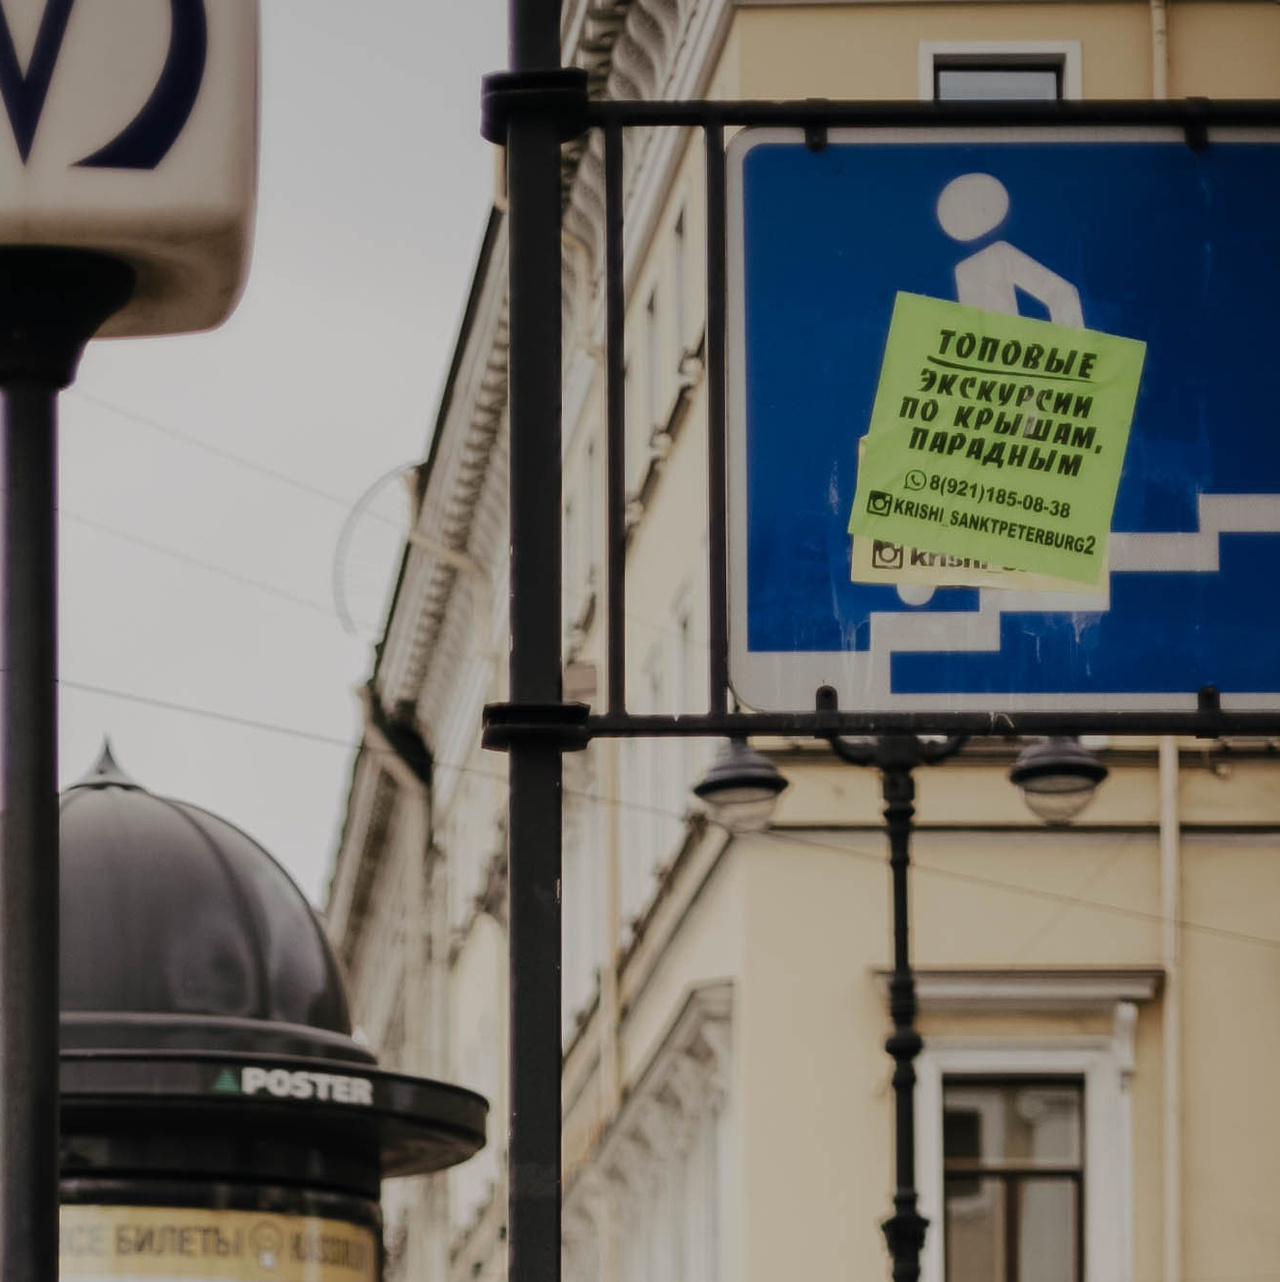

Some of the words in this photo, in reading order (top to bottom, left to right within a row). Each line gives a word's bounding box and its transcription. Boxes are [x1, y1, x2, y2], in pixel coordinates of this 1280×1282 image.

[938, 329, 1098, 379] ТОПОВЫЕ
[919, 367, 1094, 419] ЭКСКУРСИИ
[899, 396, 940, 423] ПО
[953, 405, 1104, 455] КРЫШАМ,
[908, 427, 1084, 477] ПАРАДНЫМ
[929, 474, 1071, 519] 8(921)185-08-38
[241, 1067, 373, 1105] POSTER
[114, 1223, 244, 1257] БИЛЕТЫ
